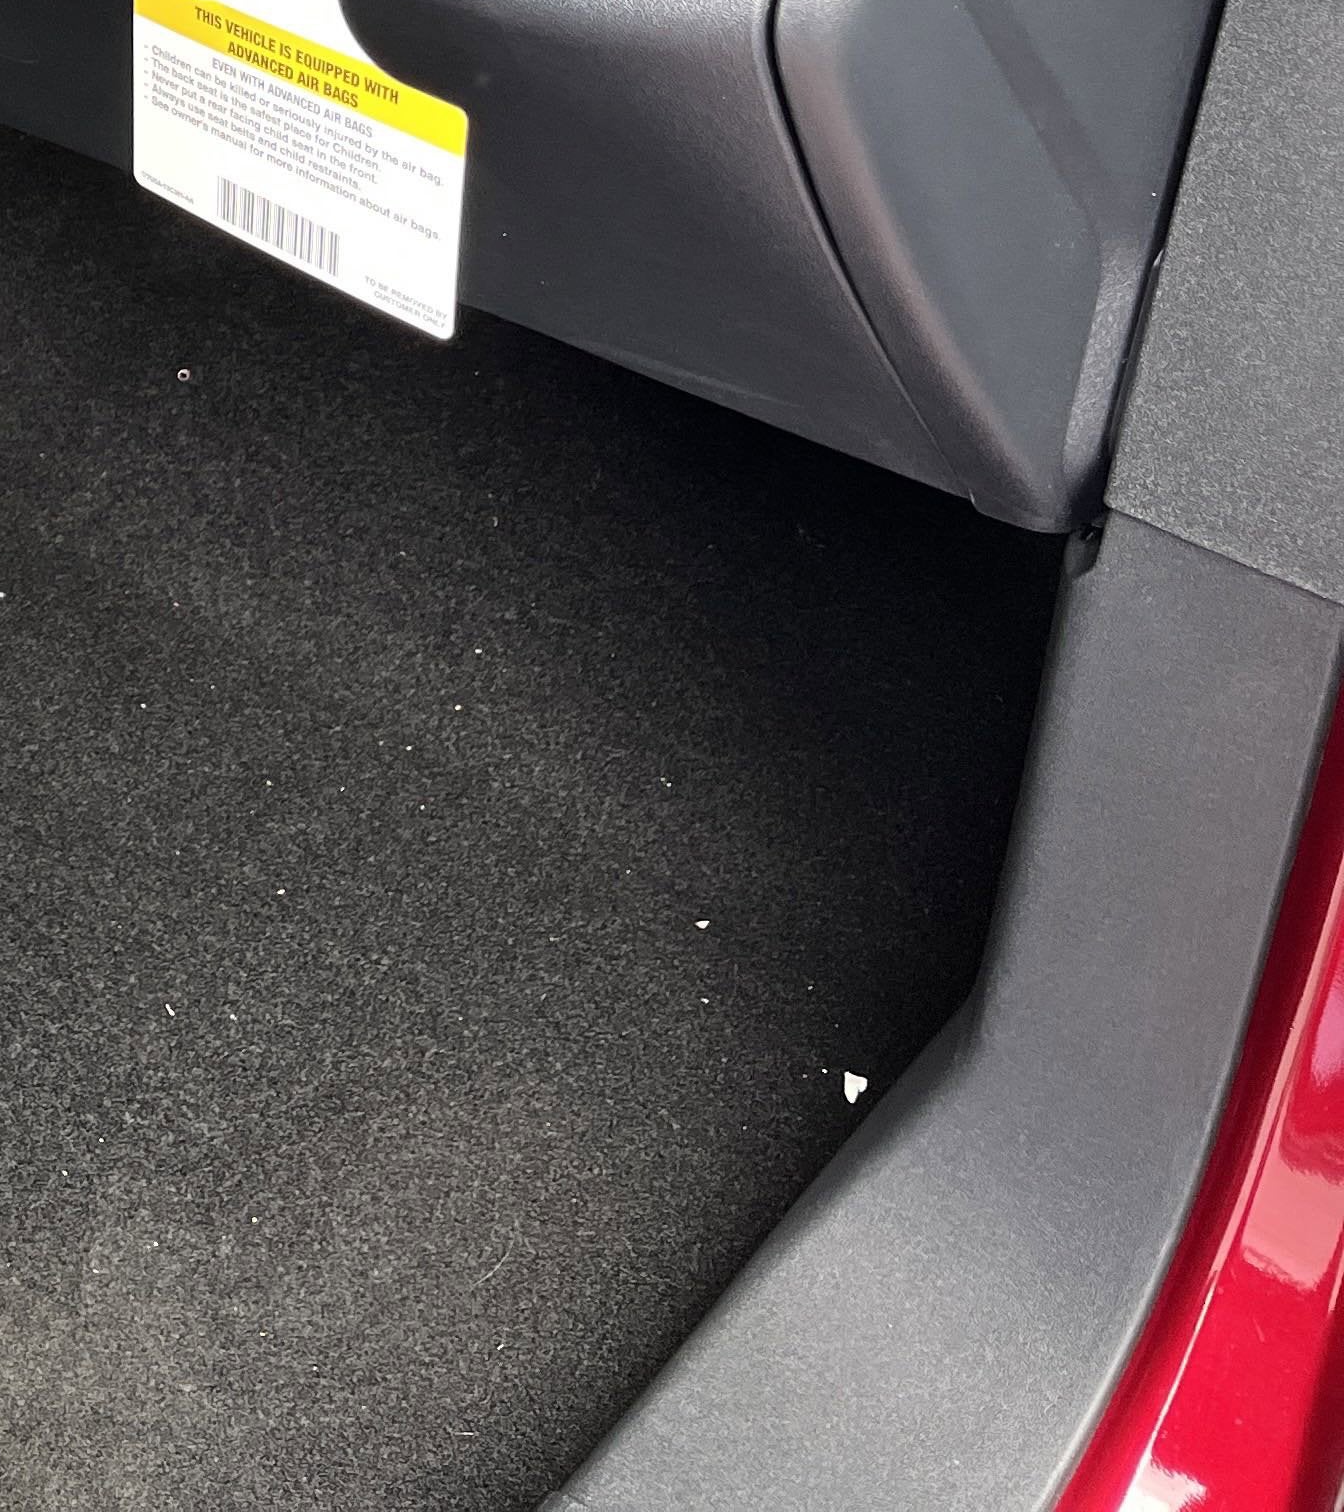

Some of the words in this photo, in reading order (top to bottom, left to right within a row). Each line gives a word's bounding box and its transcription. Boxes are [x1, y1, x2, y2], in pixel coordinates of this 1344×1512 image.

[151, 57, 169, 74] The
[171, 67, 193, 86] back
[196, 80, 217, 97] seat
[231, 96, 246, 111] the
[249, 104, 280, 126] safest
[283, 120, 311, 144] place
[314, 134, 329, 149] for
[195, 6, 221, 29] THIS
[225, 19, 276, 53] VEHICLE
[279, 42, 291, 59] IS
[295, 49, 359, 89] EQUIPPED
[364, 77, 399, 105] WITH
[212, 57, 236, 77] EVEN
[239, 70, 264, 90] WITH
[267, 82, 320, 115] ADVANCED
[323, 107, 341, 124] AIR
[344, 116, 372, 138] BAGS
[227, 40, 293, 80] ADVANCED
[296, 70, 319, 92] AIR
[323, 81, 357, 108] BAGS
[151, 44, 191, 72] Children
[194, 66, 211, 81] can
[214, 75, 226, 88] be
[229, 82, 255, 102] killed
[259, 97, 269, 108] or
[272, 102, 320, 133] seriously
[323, 125, 361, 151] injured
[364, 143, 378, 159] by
[381, 150, 398, 165] the
[401, 159, 415, 173] air
[151, 70, 178, 90] Never
[181, 85, 196, 101] put
[207, 99, 226, 115] rear
[229, 108, 260, 132] facing
[263, 124, 288, 143] child
[291, 138, 313, 155] seat
[316, 149, 326, 160] in
[329, 154, 346, 169] the
[151, 83, 184, 108] Always
[188, 102, 205, 117] use
[207, 111, 227, 127] seat
[230, 122, 254, 140] belts
[258, 135, 276, 150] and
[279, 145, 305, 164] child
[151, 95, 168, 111] See
[210, 125, 246, 150] manual
[249, 143, 264, 158] for
[266, 152, 292, 172] more
[295, 165, 356, 202] information
[359, 195, 390, 218] about
[393, 211, 407, 226] air
